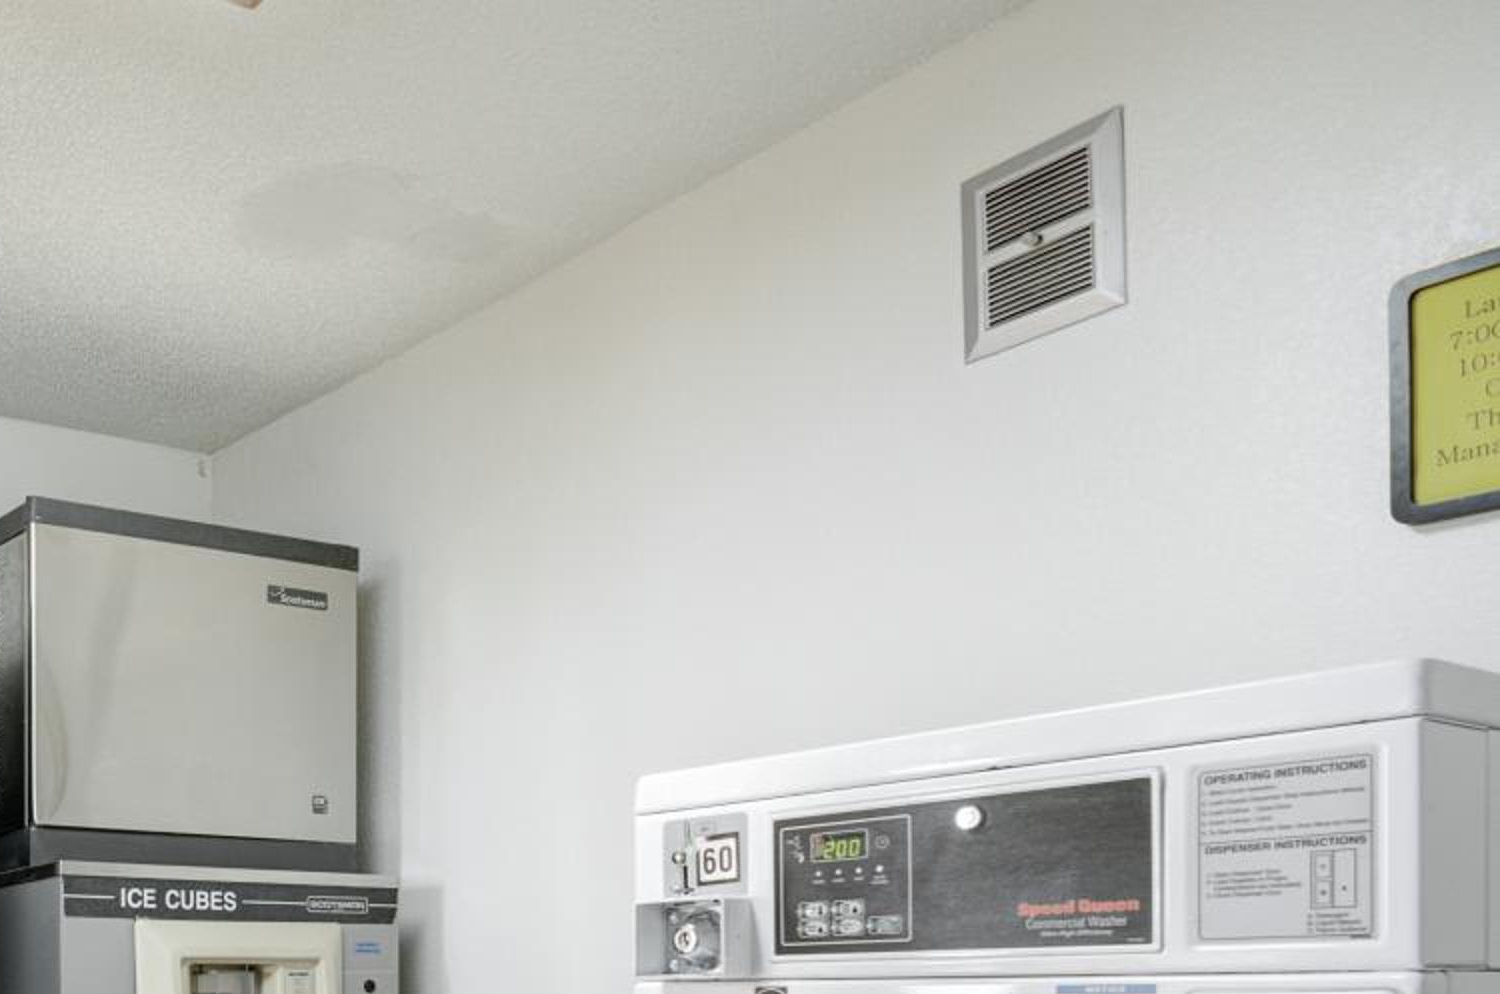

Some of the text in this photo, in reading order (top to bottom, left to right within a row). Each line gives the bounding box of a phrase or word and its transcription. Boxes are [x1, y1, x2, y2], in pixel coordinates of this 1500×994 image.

[1465, 298, 1500, 319] La
[1461, 352, 1500, 377] 10:
[1203, 759, 1367, 787] OPERATING INSTRUCTIONS
[823, 836, 861, 859] 200
[1204, 835, 1367, 856] DISPENSER INSTRUCTIONS
[702, 846, 733, 875] 60
[120, 887, 238, 911] ICE CUBES
[1017, 899, 1140, 918] Speed Queen
